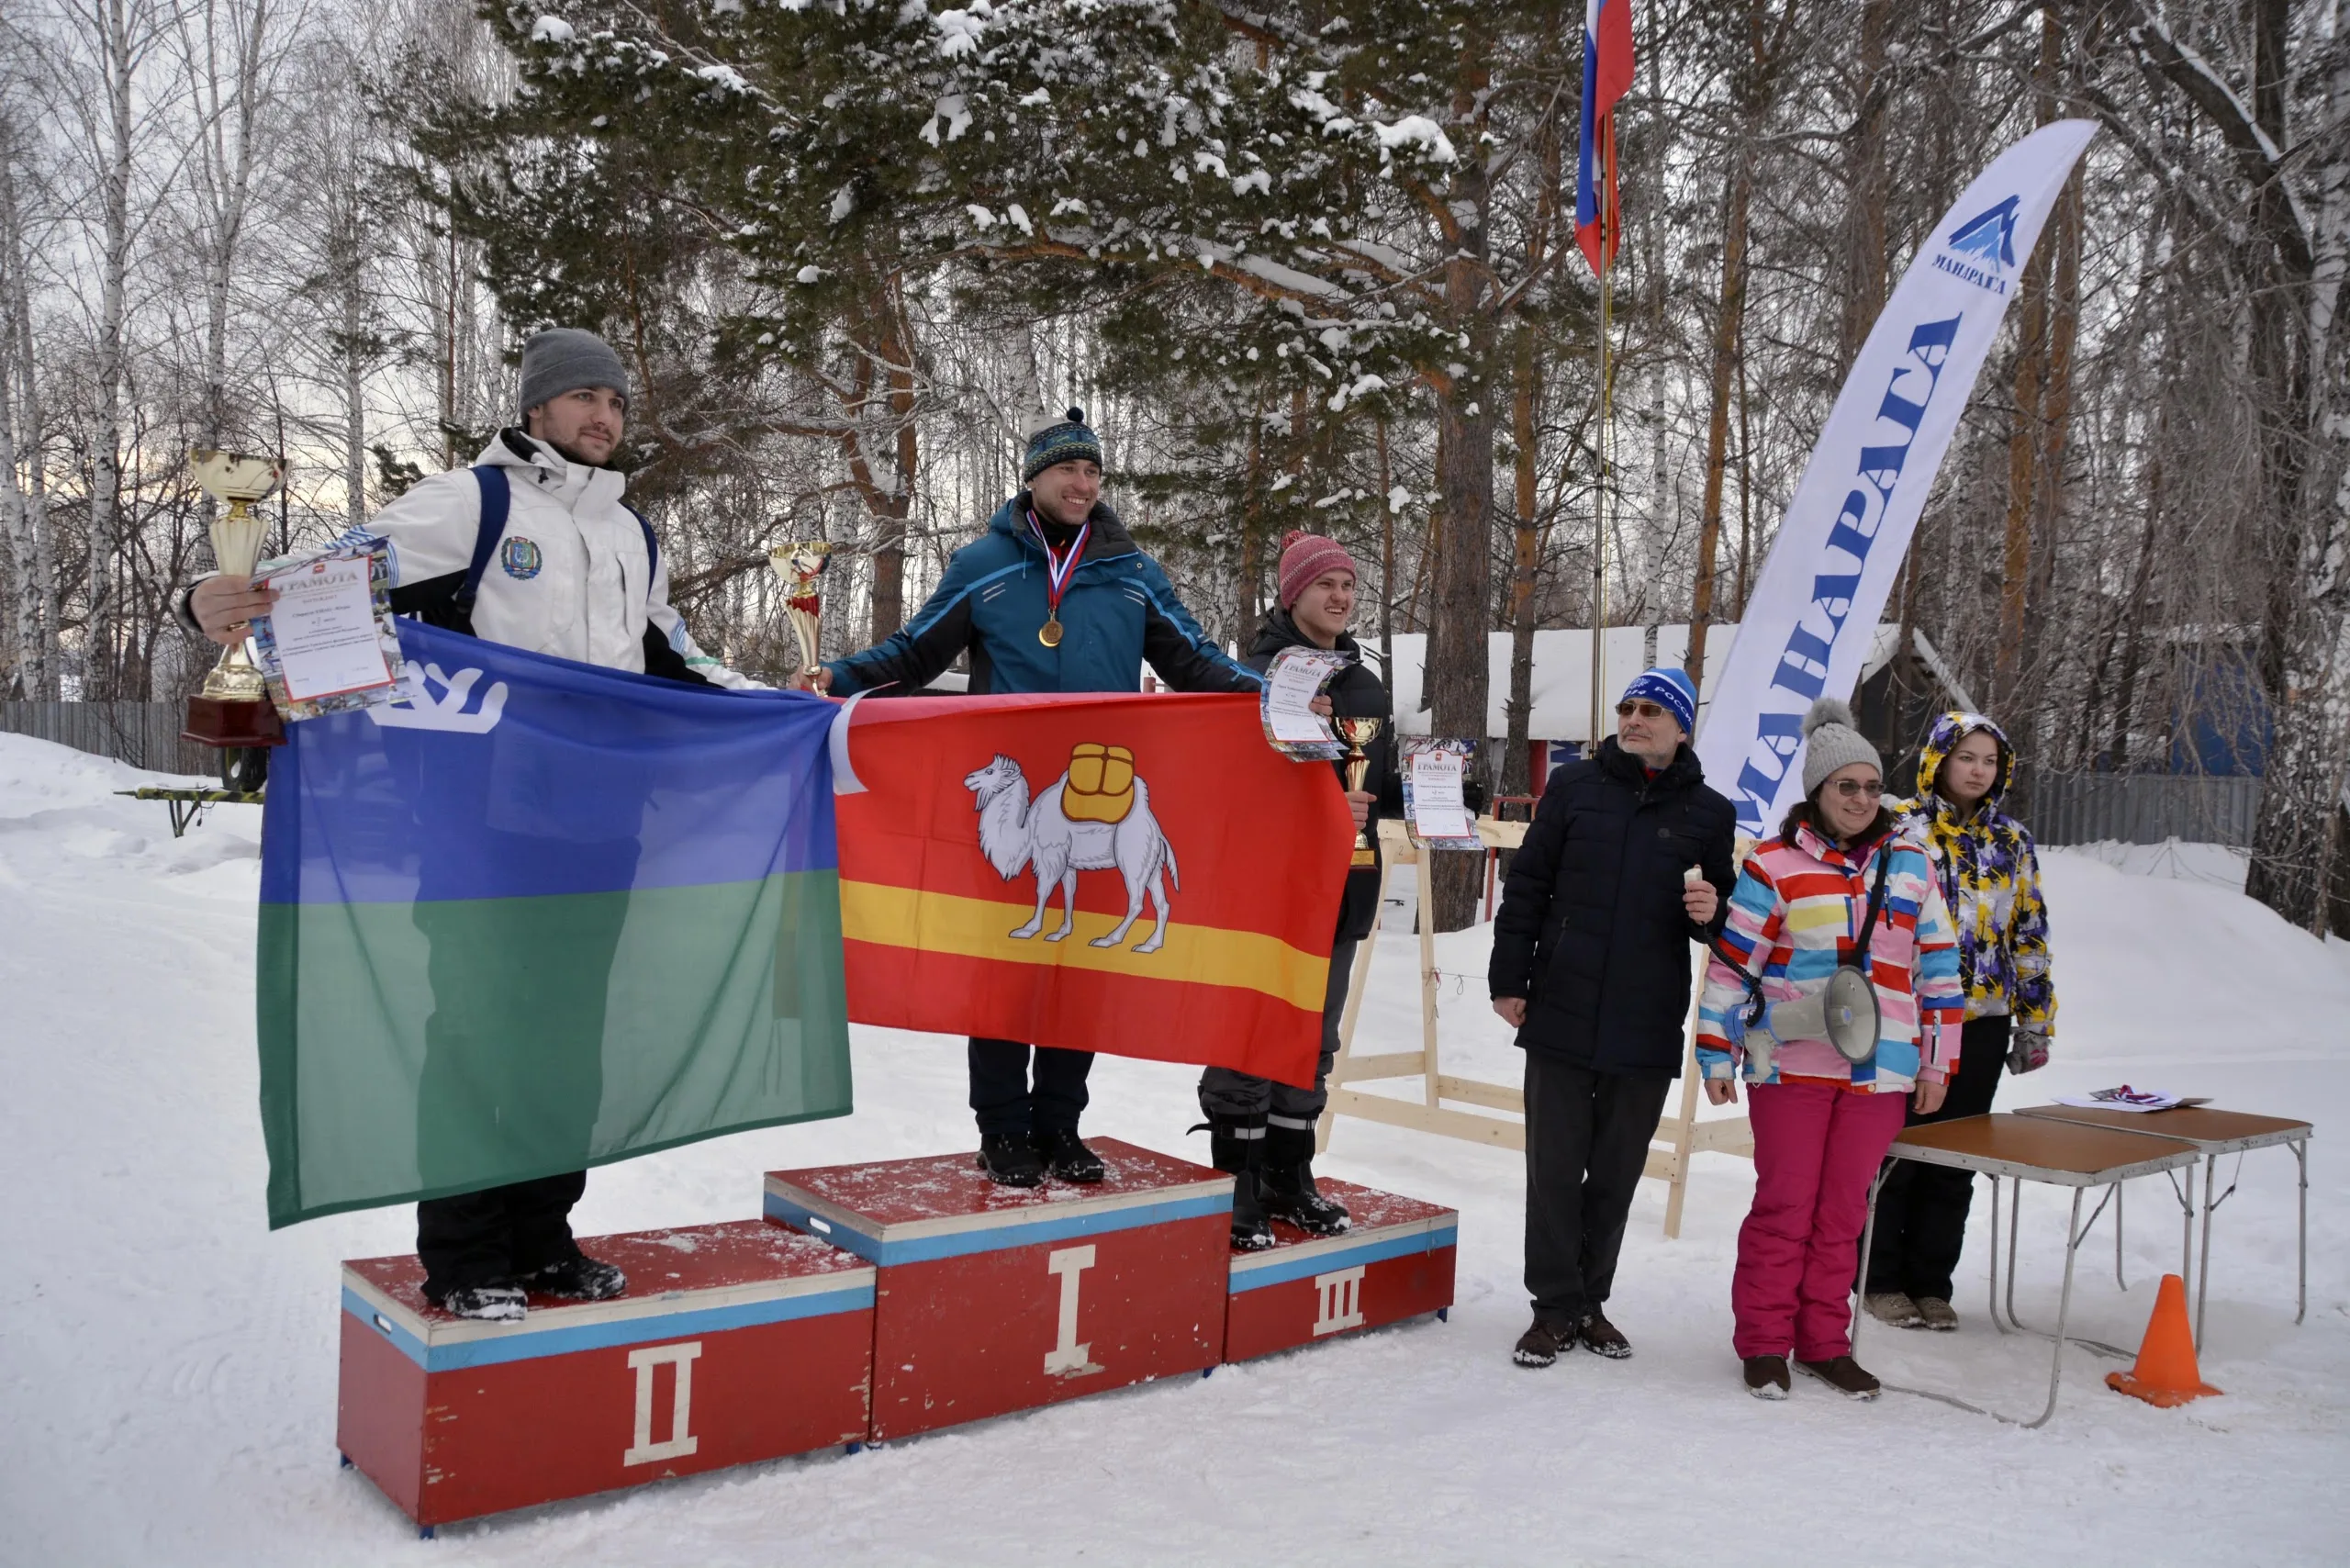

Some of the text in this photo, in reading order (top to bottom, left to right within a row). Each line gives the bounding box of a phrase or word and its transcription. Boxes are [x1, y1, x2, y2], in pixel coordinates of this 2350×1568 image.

[1931, 253, 2007, 295] МАНАРАГА
[278, 570, 358, 592] ГРАМОТА
[1730, 311, 1964, 840] МАНАРАГА
[1416, 762, 1458, 772] ГРАМОТА
[1044, 1244, 1097, 1377] I
[1313, 1264, 1366, 1338] III
[623, 1340, 702, 1467] II
